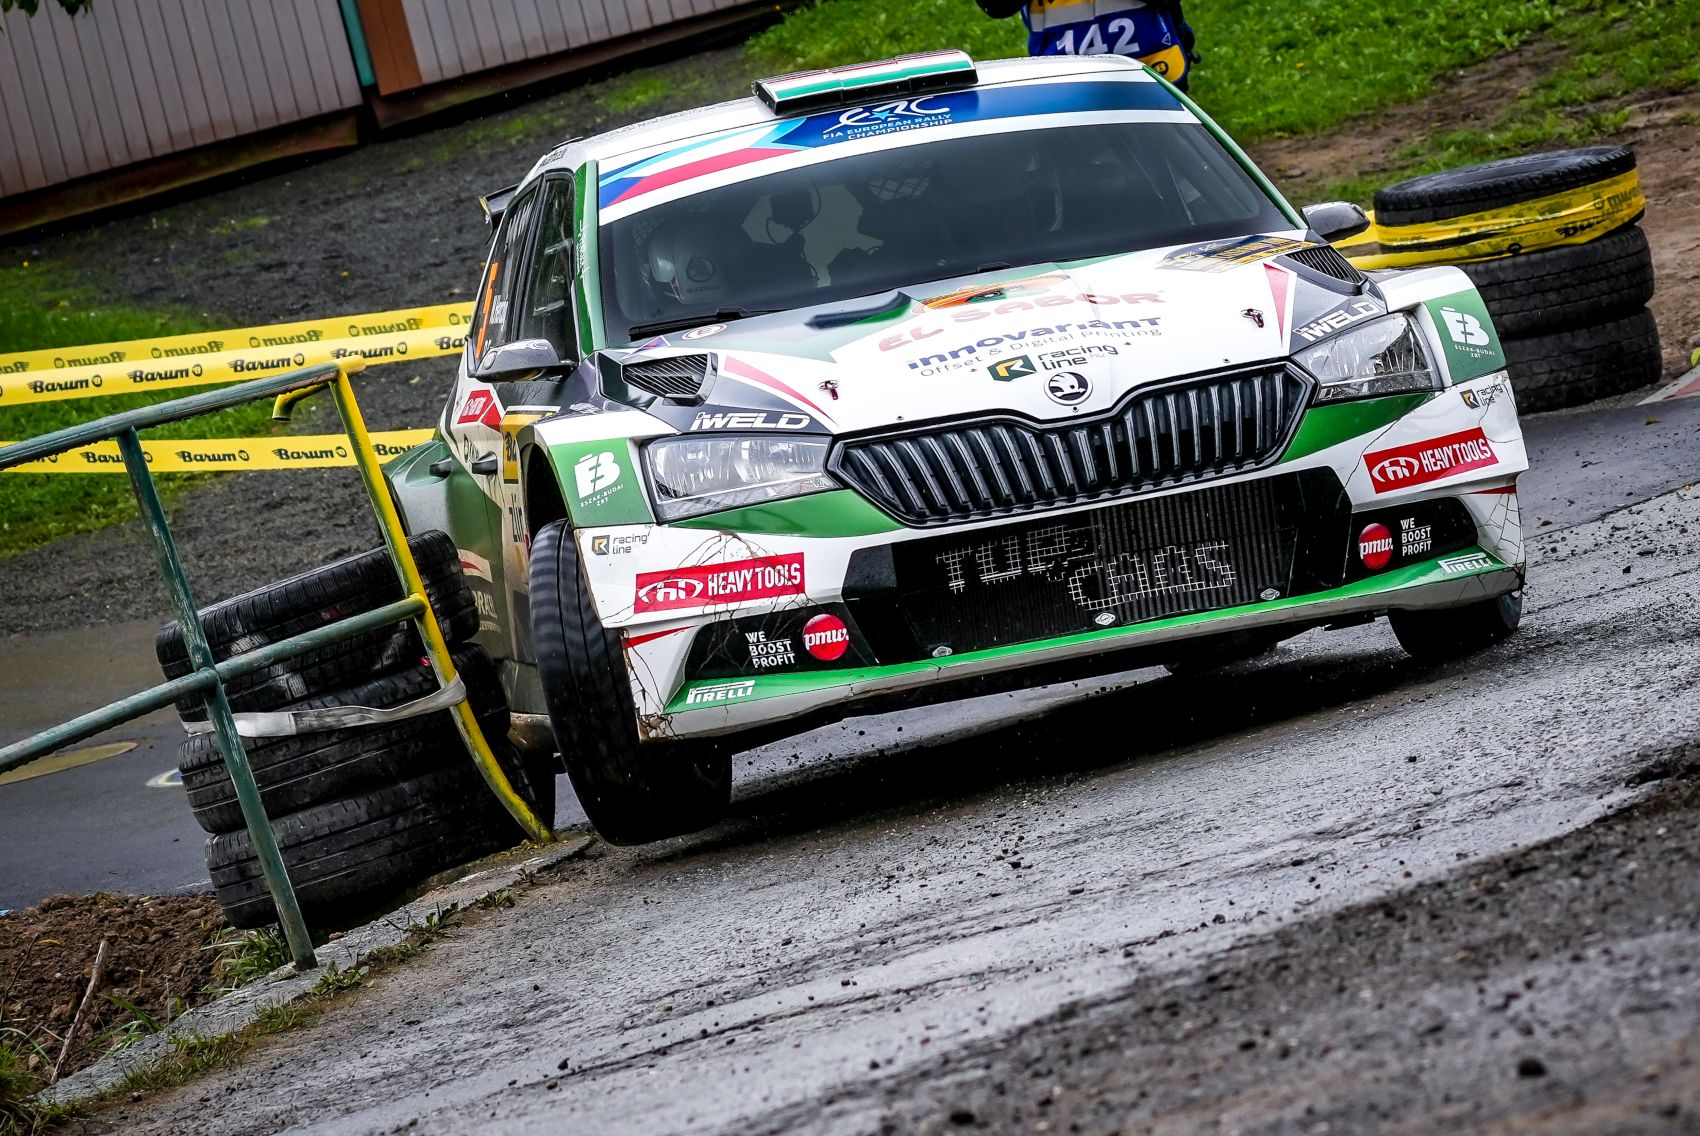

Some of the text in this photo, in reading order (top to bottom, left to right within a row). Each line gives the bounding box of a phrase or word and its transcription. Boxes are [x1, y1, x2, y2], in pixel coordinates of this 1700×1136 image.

[1056, 17, 1140, 55] 142
[823, 113, 951, 139] FIA EUROPEAN RALLY
[848, 118, 952, 140] CHAMPIONSHIP
[878, 326, 944, 352] EL
[920, 327, 1162, 377] Offset & Digital Printing
[1037, 345, 1119, 360] racing
[1041, 356, 1088, 371] line
[28, 378, 89, 394] Barum
[128, 366, 189, 384] Barum
[229, 357, 291, 373] Barum
[1476, 385, 1503, 398] racing
[1481, 395, 1496, 406] line
[80, 451, 124, 463] Baru
[175, 450, 236, 463] Barum
[272, 447, 334, 460] Barum
[1419, 437, 1491, 474] HEAVY TOOLS
[1400, 517, 1415, 529] WE
[613, 533, 648, 544] racing
[1401, 526, 1431, 543] BOOST
[612, 545, 632, 555] line
[1402, 541, 1432, 556] PROFIT
[1438, 552, 1492, 574] PIRELLI
[708, 563, 801, 596] HEAVY TOOLS
[745, 631, 767, 643] WE
[749, 640, 791, 656] BOOST
[752, 653, 796, 668] PROFIT
[686, 680, 755, 704] PIRELLI
